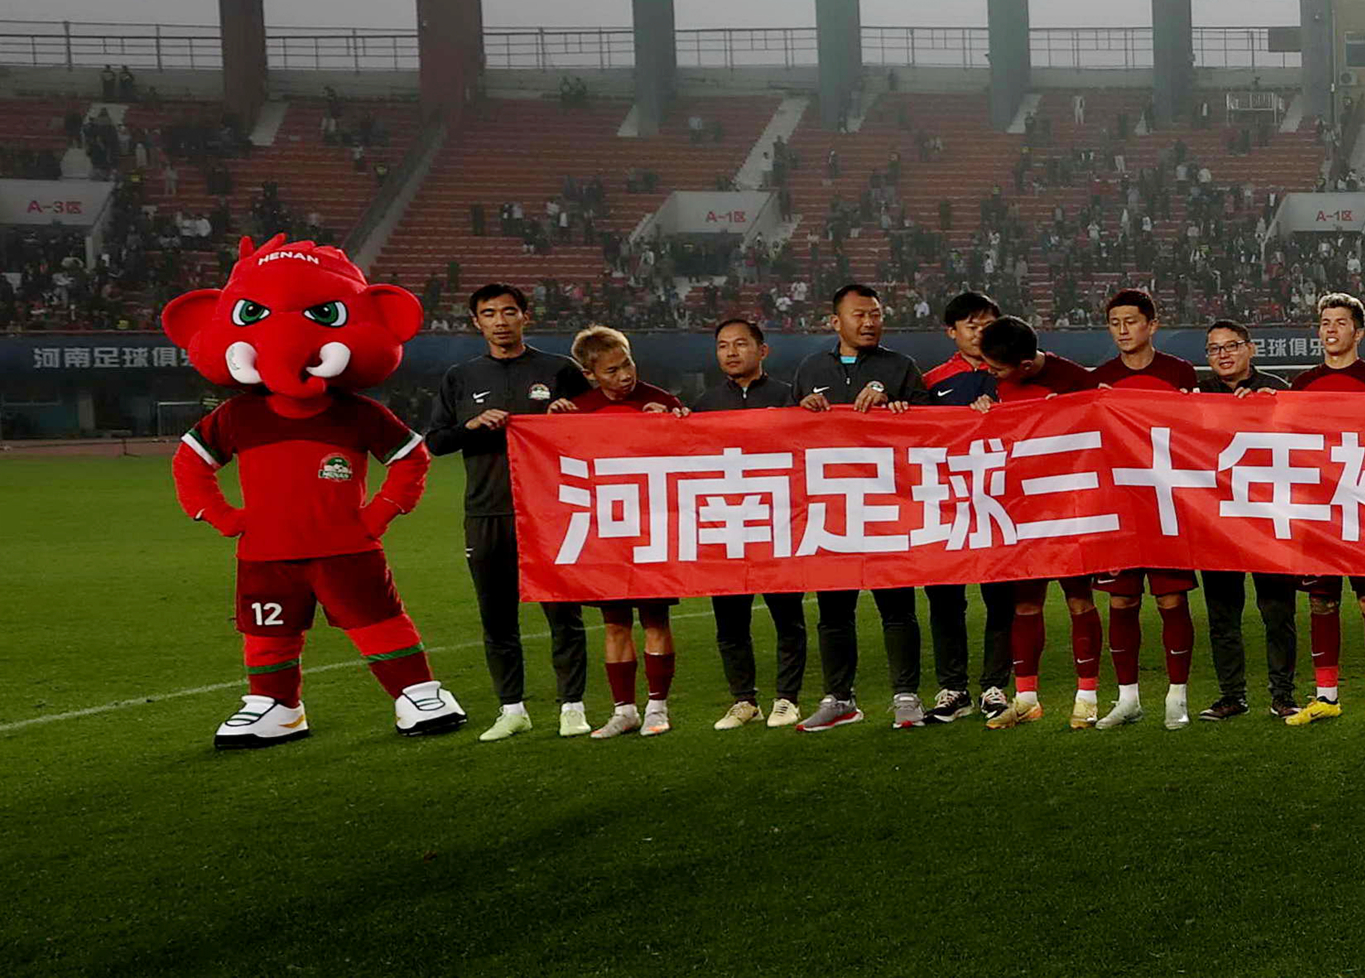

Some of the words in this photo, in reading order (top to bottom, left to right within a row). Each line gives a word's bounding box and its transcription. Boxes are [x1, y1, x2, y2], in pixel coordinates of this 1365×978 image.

[1315, 210, 1354, 222] A-1区
[258, 251, 319, 266] HENAN
[251, 602, 284, 626] 12
